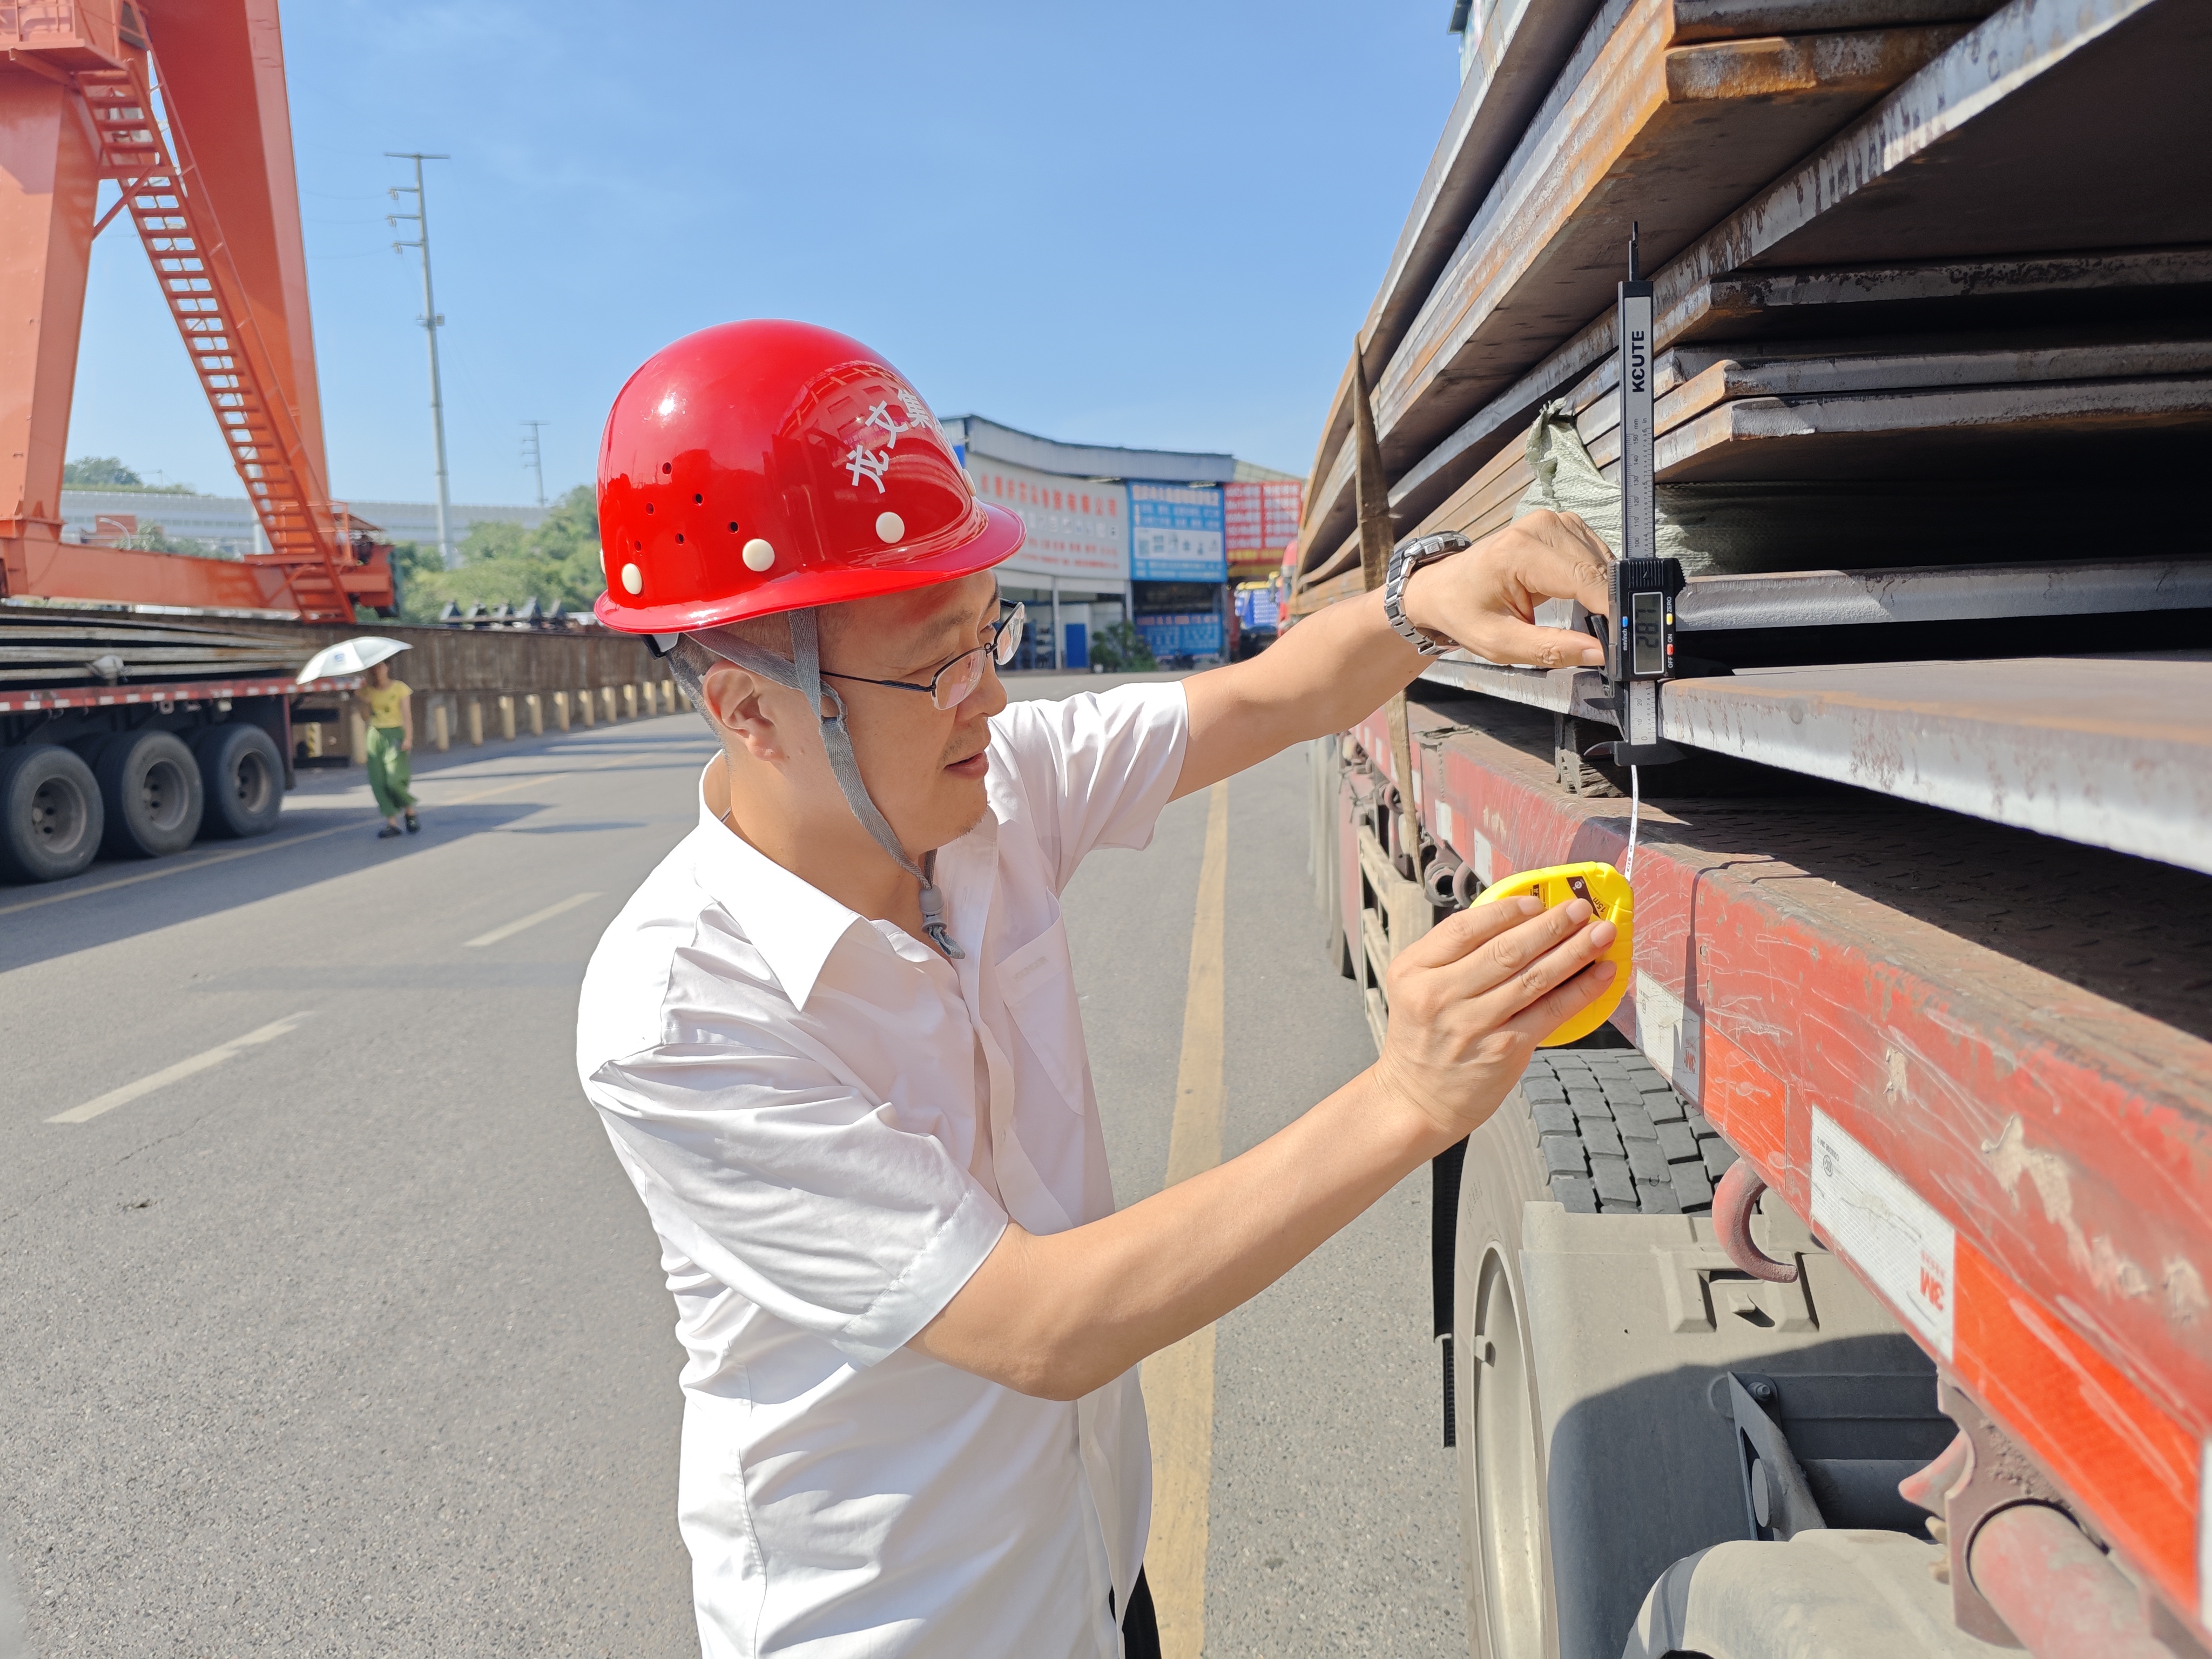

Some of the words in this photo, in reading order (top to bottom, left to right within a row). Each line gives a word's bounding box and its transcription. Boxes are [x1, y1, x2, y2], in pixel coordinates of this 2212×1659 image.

[1634, 419, 1638, 429] mm
[846, 388, 942, 494] 龙文集
[1668, 633, 1673, 643] ON
[1593, 897, 1606, 913] 15m
[1683, 1050, 1696, 1074] 3M
[1920, 1266, 1944, 1311] 3M
